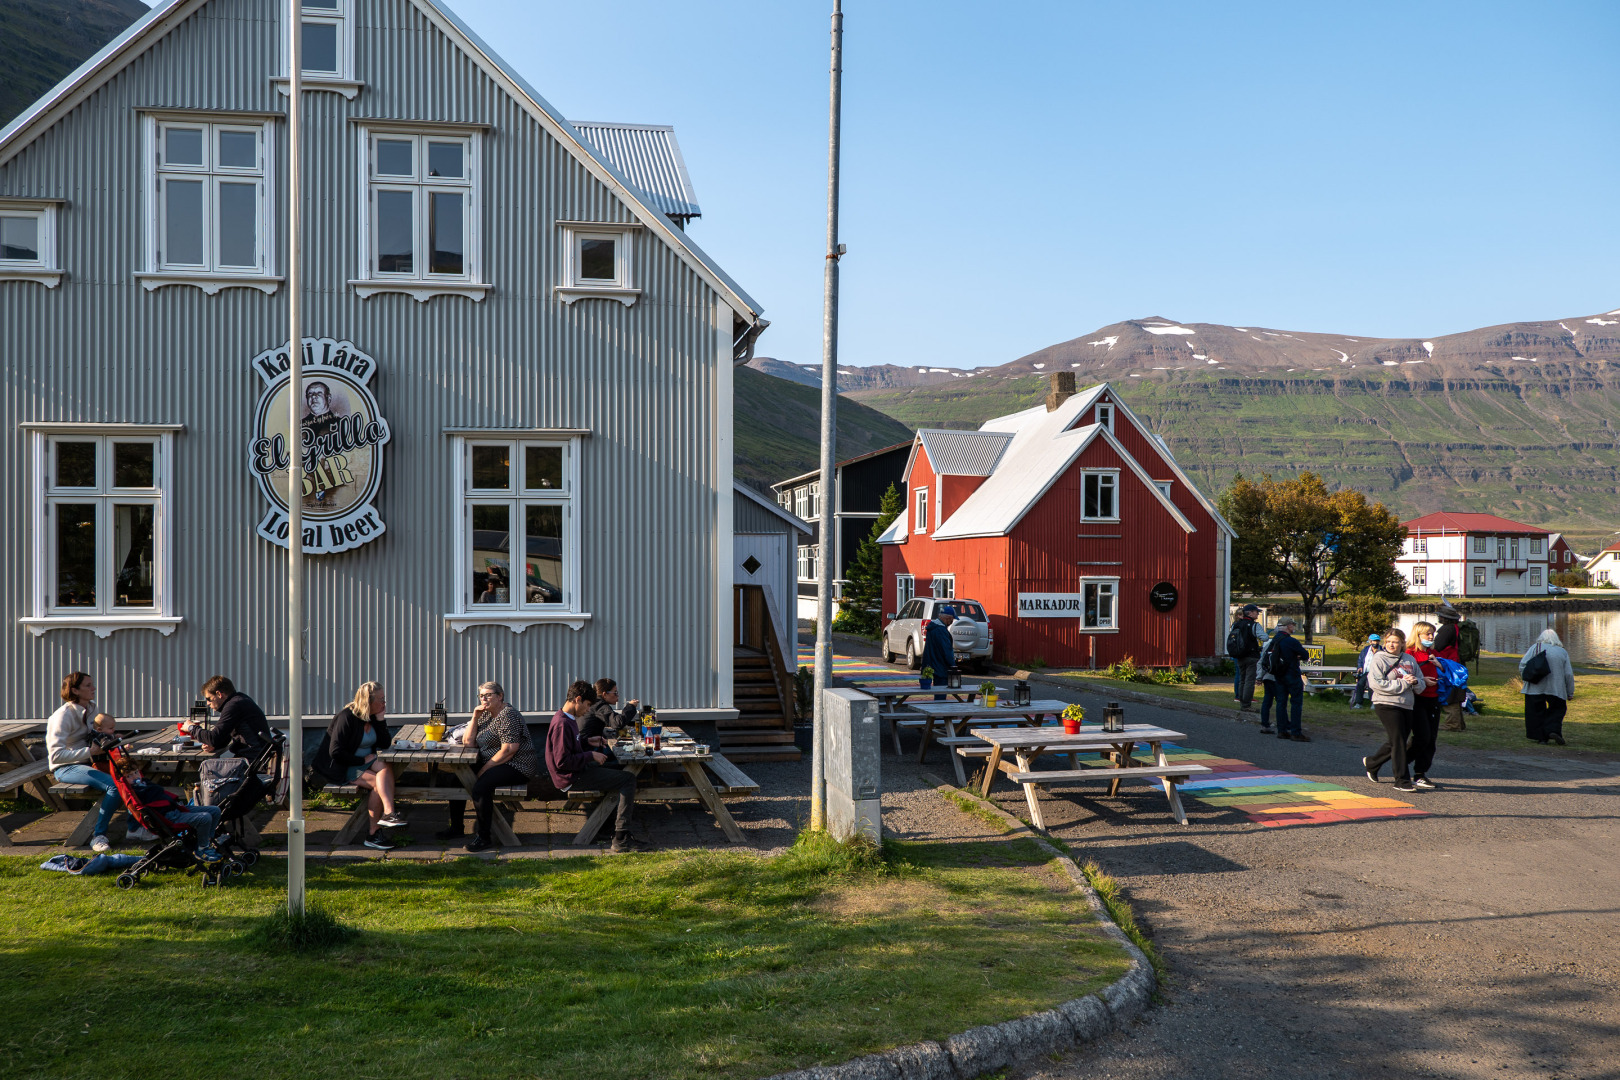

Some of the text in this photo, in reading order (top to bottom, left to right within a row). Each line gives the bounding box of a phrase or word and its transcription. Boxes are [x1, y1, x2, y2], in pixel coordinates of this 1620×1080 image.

[258, 342, 370, 380] Kai Lára
[254, 433, 289, 475] El
[263, 510, 380, 548] Loal beer
